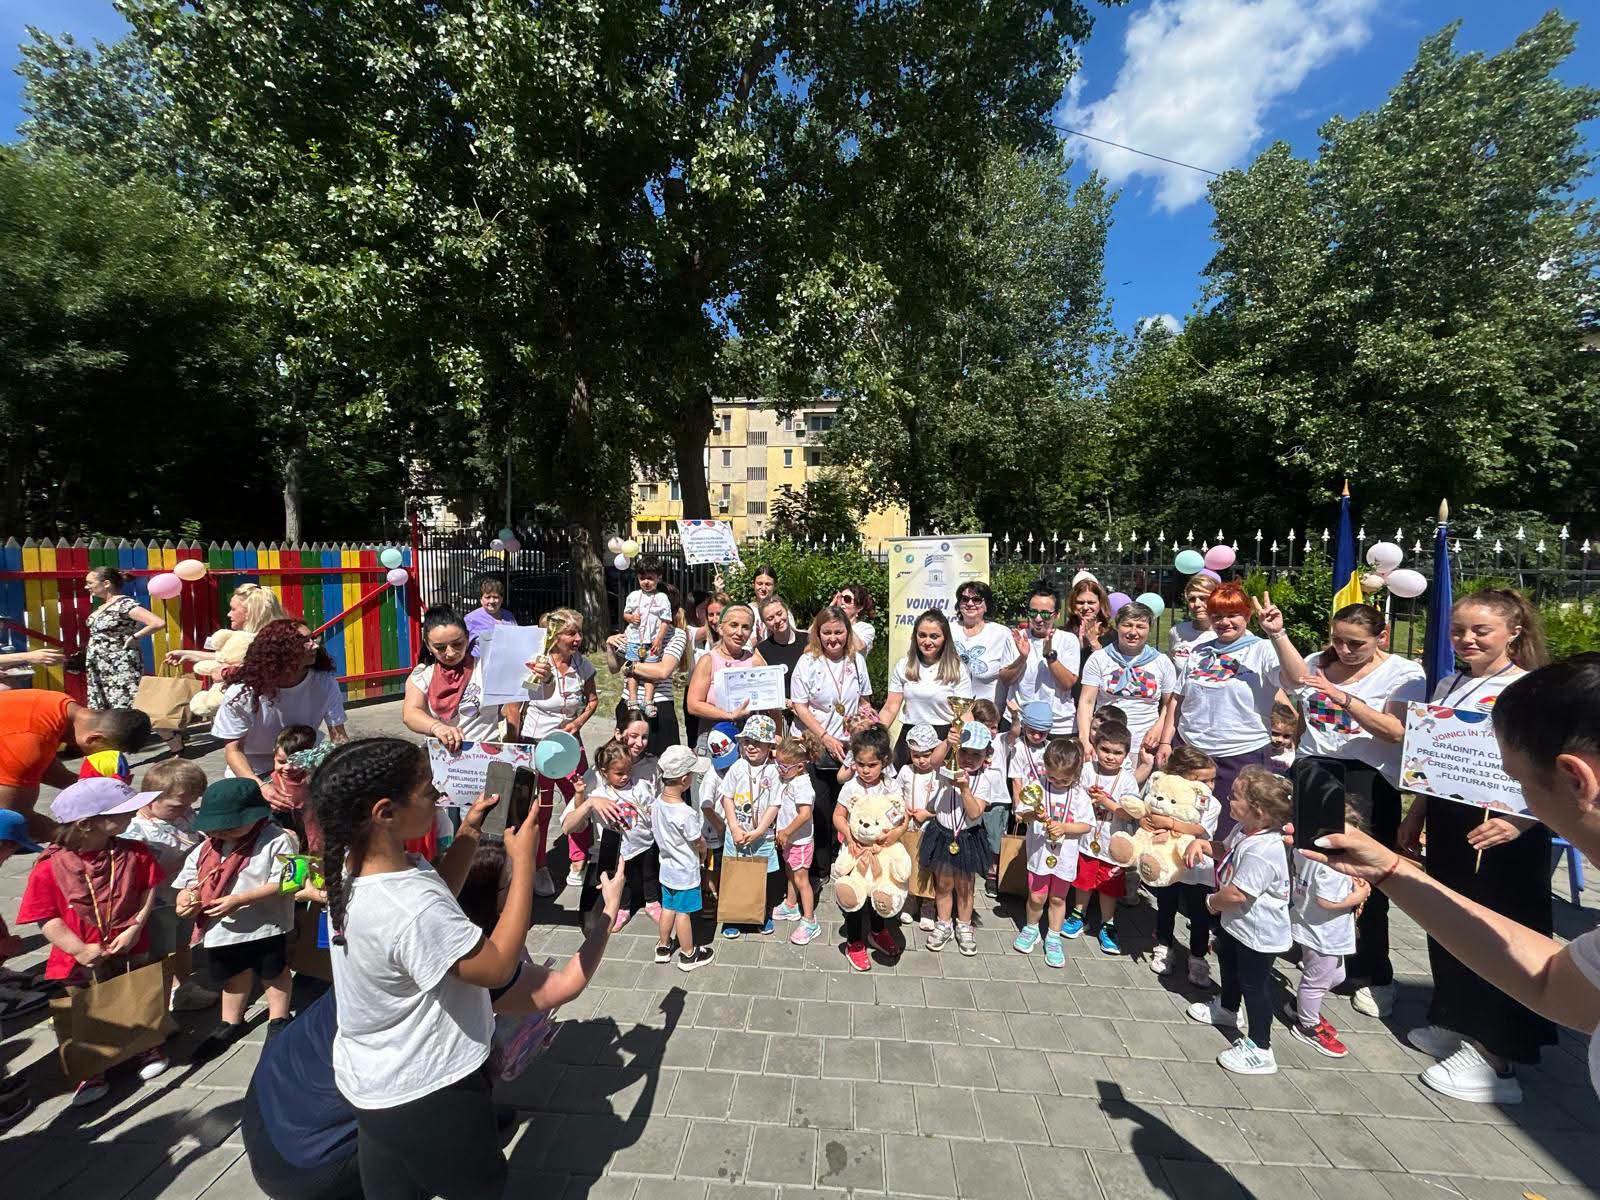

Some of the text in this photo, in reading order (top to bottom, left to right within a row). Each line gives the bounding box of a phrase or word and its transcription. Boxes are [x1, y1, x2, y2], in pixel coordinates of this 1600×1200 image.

[906, 598, 949, 610] VOINICI
[1432, 730, 1467, 742] VOINICI
[1416, 747, 1470, 764] PRELUNGIT
[1462, 767, 1491, 778] NR.13
[1502, 785, 1521, 795] VES
